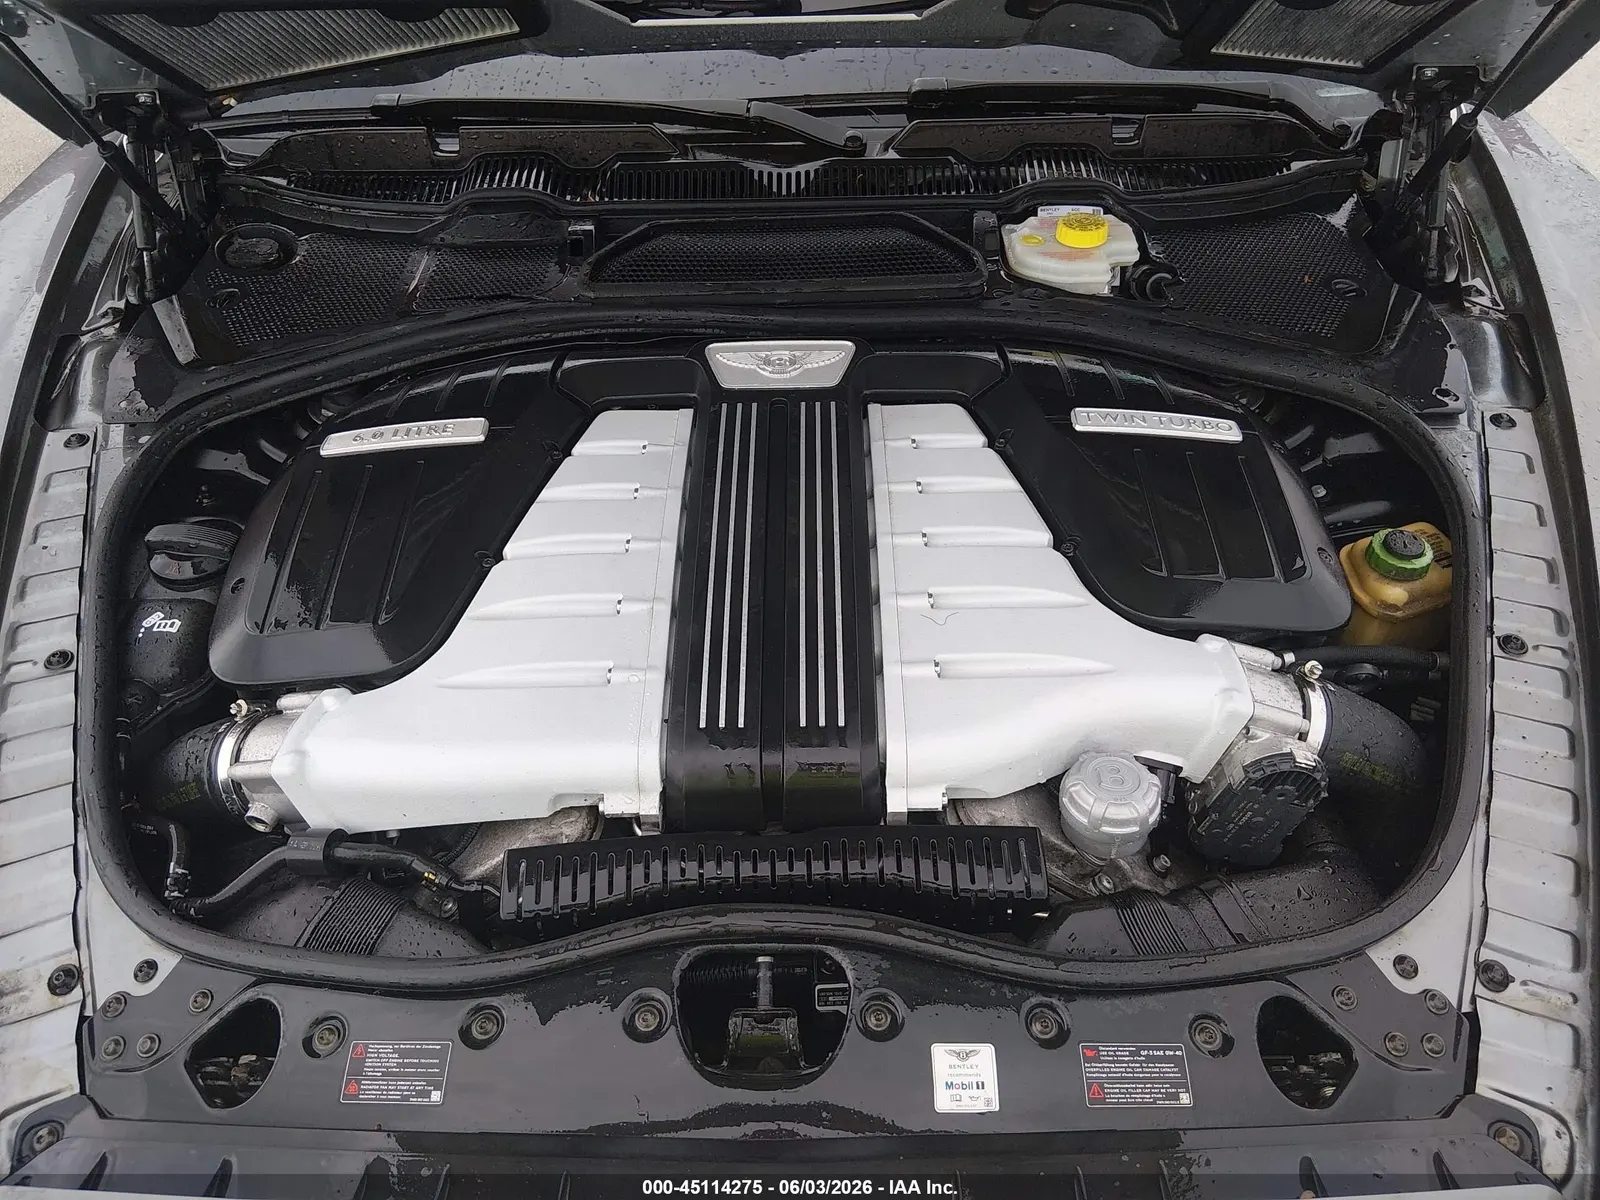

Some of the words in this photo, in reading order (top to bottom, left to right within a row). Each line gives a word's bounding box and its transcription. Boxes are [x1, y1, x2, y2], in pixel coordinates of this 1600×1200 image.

[1080, 411, 1147, 426] TWIN
[1152, 415, 1233, 432] TURBO
[352, 430, 384, 444] 6.0
[391, 422, 455, 440] LITRE
[1096, 765, 1132, 791] B
[945, 1081, 974, 1091] Mobil
[975, 1081, 985, 1090] 1
